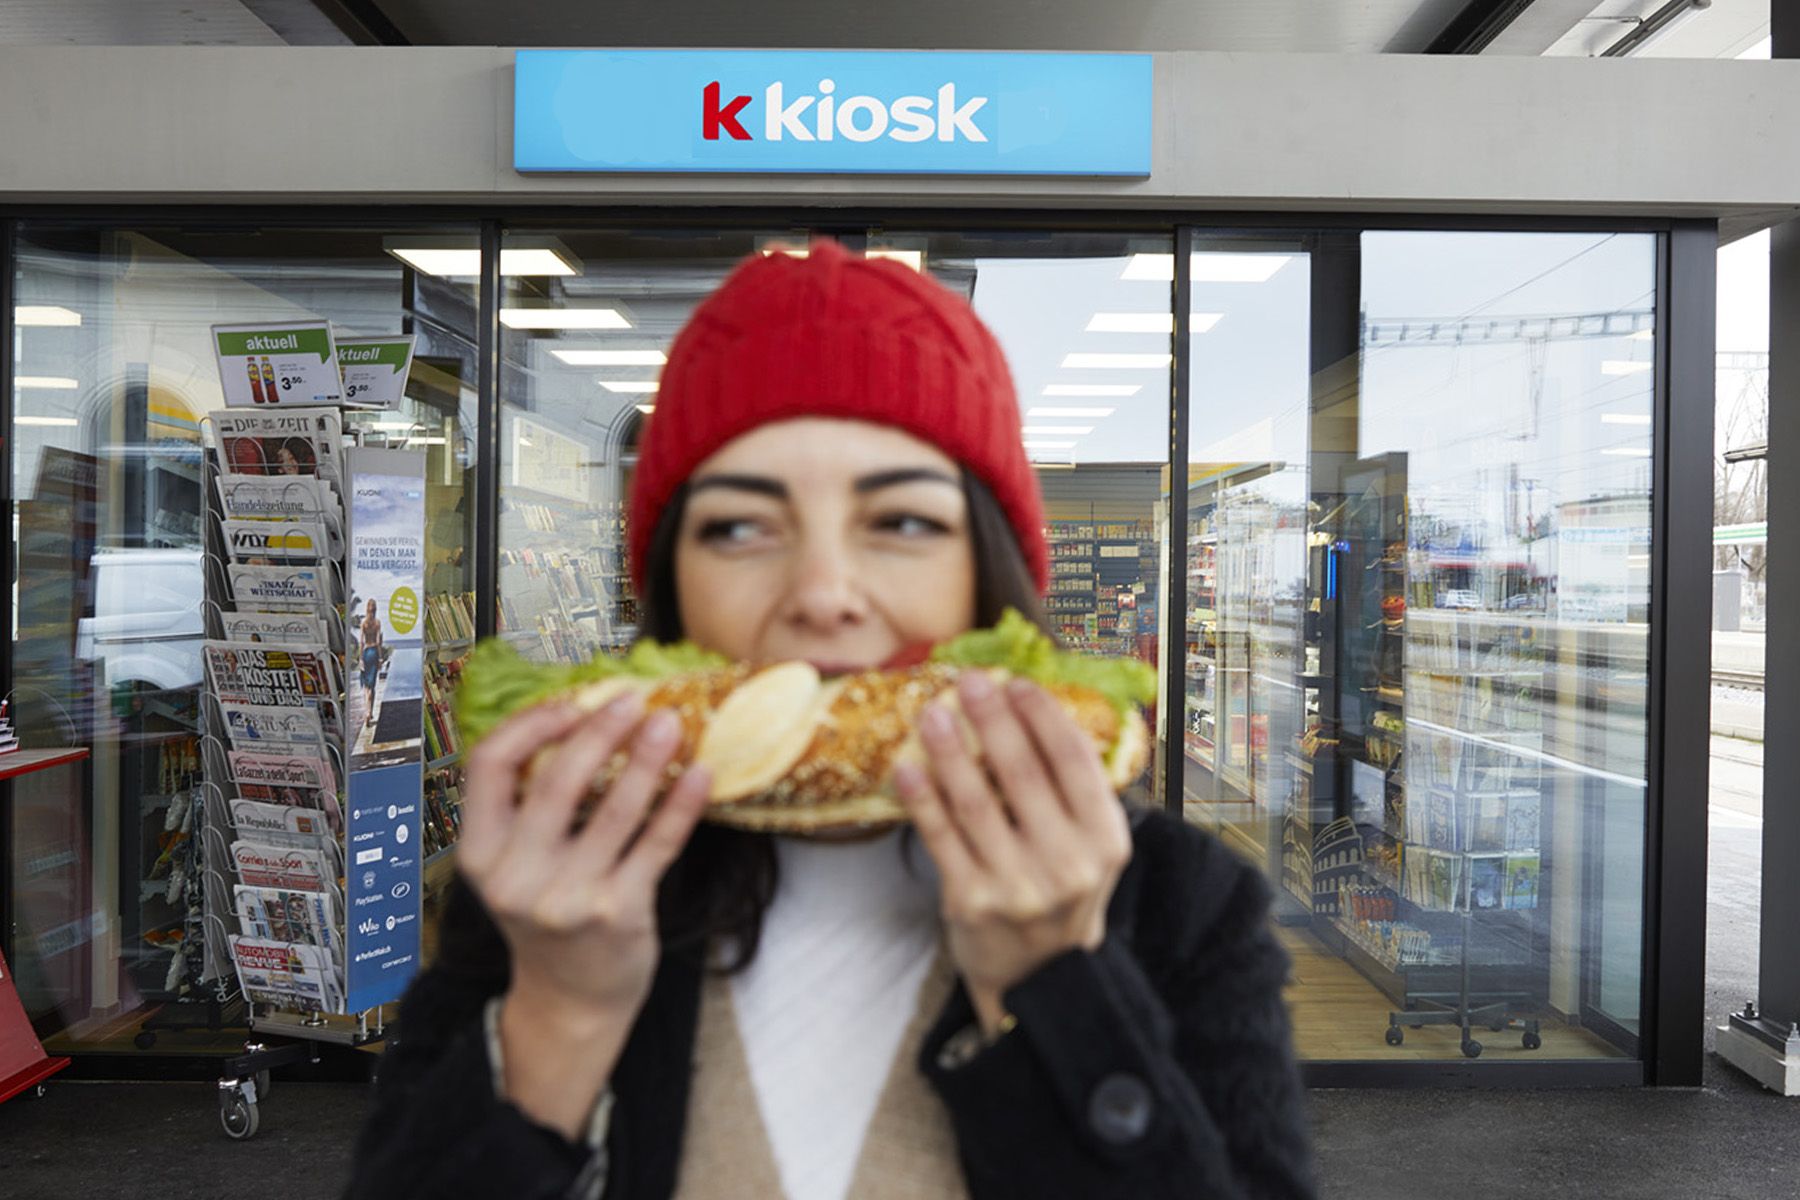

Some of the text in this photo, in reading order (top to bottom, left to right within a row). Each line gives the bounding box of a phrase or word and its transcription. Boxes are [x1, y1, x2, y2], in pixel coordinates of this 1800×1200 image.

[703, 78, 989, 142] k kiosk
[246, 335, 299, 351] aktuell
[279, 417, 311, 432] ZEIT
[398, 548, 417, 558] MAN
[357, 560, 380, 570] ALLES
[240, 650, 268, 668] DAS
[244, 668, 298, 687] KOSTET
